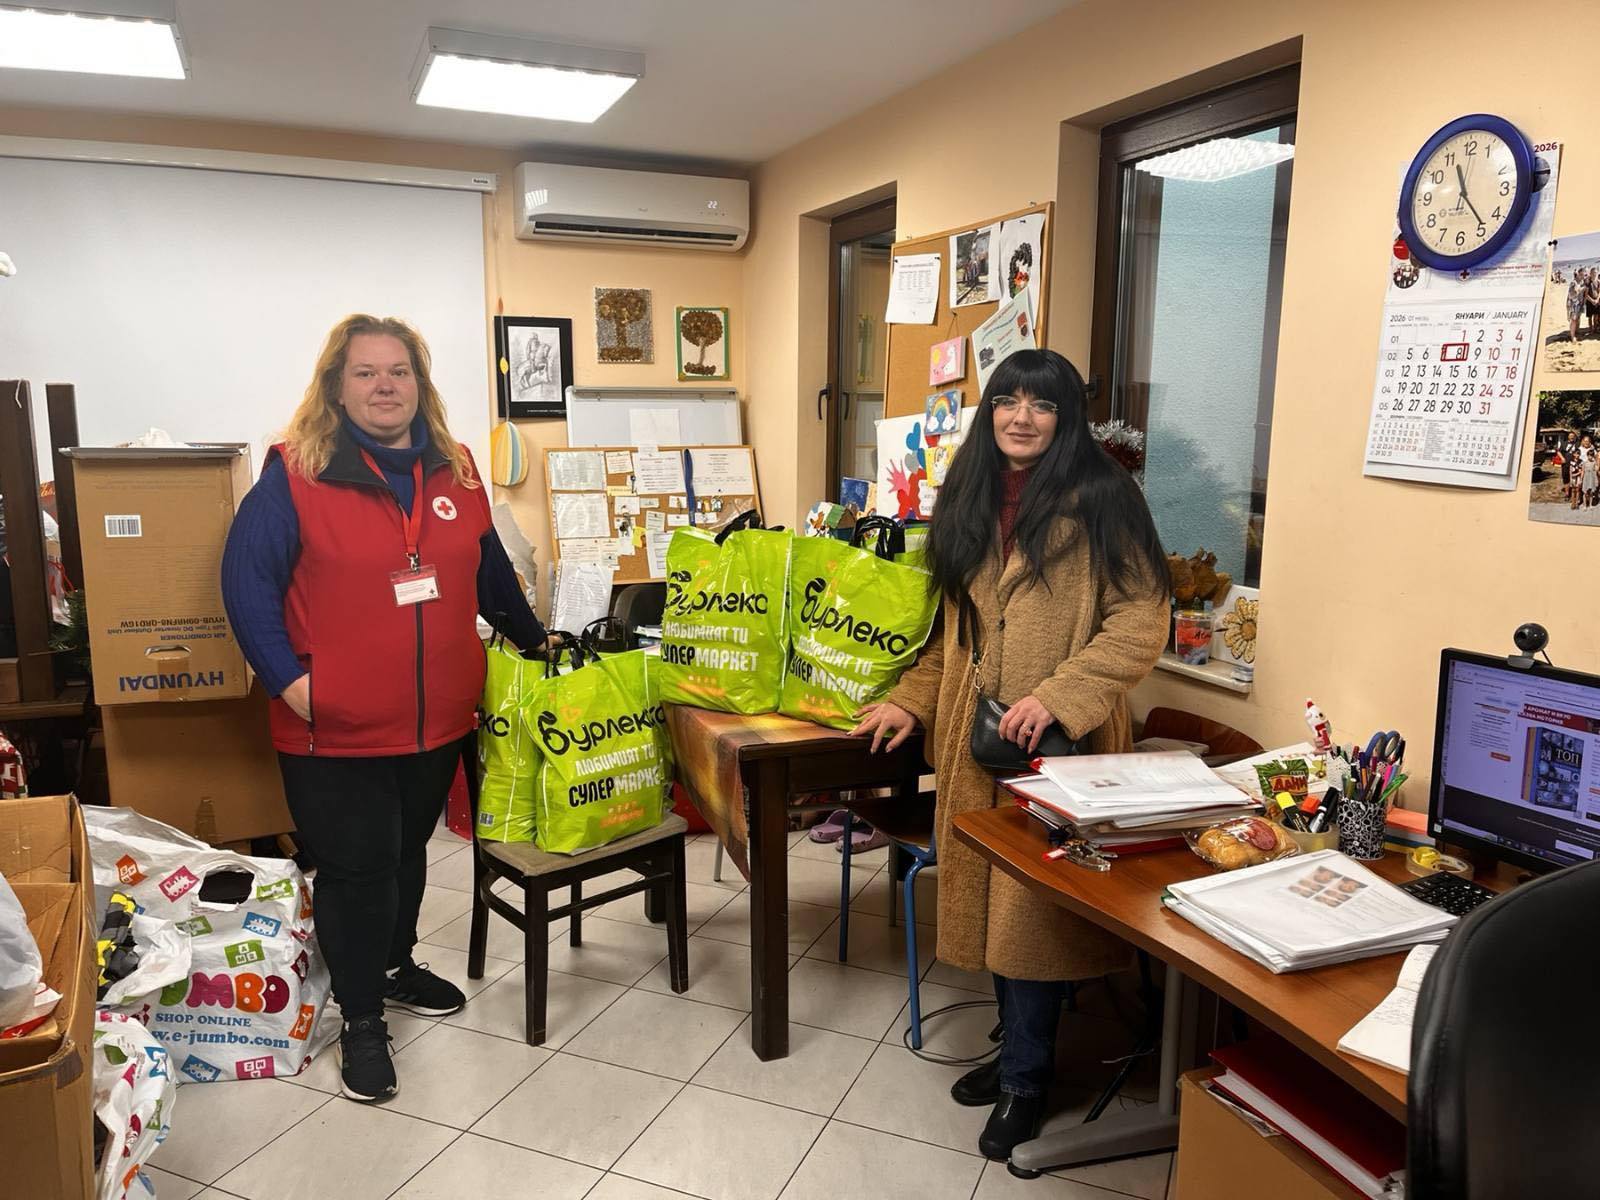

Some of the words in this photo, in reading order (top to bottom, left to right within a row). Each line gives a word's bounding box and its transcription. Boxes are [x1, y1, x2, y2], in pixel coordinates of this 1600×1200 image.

[1464, 140, 1478, 156] 12
[1485, 145, 1491, 158] 1
[1534, 142, 1558, 152] 2026
[1445, 152, 1455, 167] 11
[1431, 170, 1444, 184] 10
[1499, 181, 1510, 196] 3
[707, 200, 718, 209] 22
[1423, 192, 1432, 206] 9
[1427, 213, 1436, 228] 8
[1491, 207, 1501, 220] 4
[1439, 228, 1448, 242] 7
[1476, 222, 1486, 237] 5
[1456, 231, 1465, 246] 6
[1390, 314, 1406, 322] 2026
[1455, 312, 1485, 320] ЯНУАРИ
[1492, 311, 1528, 319] JANUARY
[1462, 329, 1467, 342] 1
[1477, 329, 1485, 342] 2
[1496, 329, 1504, 342] 3
[1515, 329, 1523, 342] 4
[1406, 348, 1413, 360] 5
[1422, 348, 1429, 360] 6
[1474, 347, 1482, 360] 9
[1488, 347, 1500, 360] 10
[1511, 348, 1520, 360] 11
[1385, 369, 1394, 377] 03
[1401, 365, 1411, 377] 12
[1417, 365, 1426, 377] 13
[1432, 365, 1442, 377] 14
[1449, 365, 1460, 378] 15
[1467, 365, 1477, 378] 16
[1487, 366, 1498, 378] 17
[1505, 366, 1517, 379] 18
[1398, 382, 1407, 394] 19
[1410, 382, 1423, 394] 20
[1428, 382, 1439, 395] 21
[1443, 383, 1457, 395] 22
[1461, 383, 1475, 396] 23
[1479, 384, 1493, 397] 24
[1499, 384, 1514, 398] 25
[1392, 398, 1404, 411] 26
[1408, 399, 1420, 411] 27
[1423, 399, 1436, 412] 28
[1439, 400, 1454, 413] 29
[1456, 401, 1471, 414] 30
[1479, 402, 1491, 415] 31
[801, 577, 908, 656] бурлекс
[661, 643, 759, 671] УПЕРМАРКЕТ
[119, 671, 224, 691] HYUNDAI
[538, 706, 666, 755] бурлекс
[569, 765, 661, 807] СУПЕРМАРКЕ
[155, 1013, 194, 1023] SHOP
[197, 1015, 251, 1027] ONLINE
[151, 1030, 290, 1048] w.e-jumbo.com
